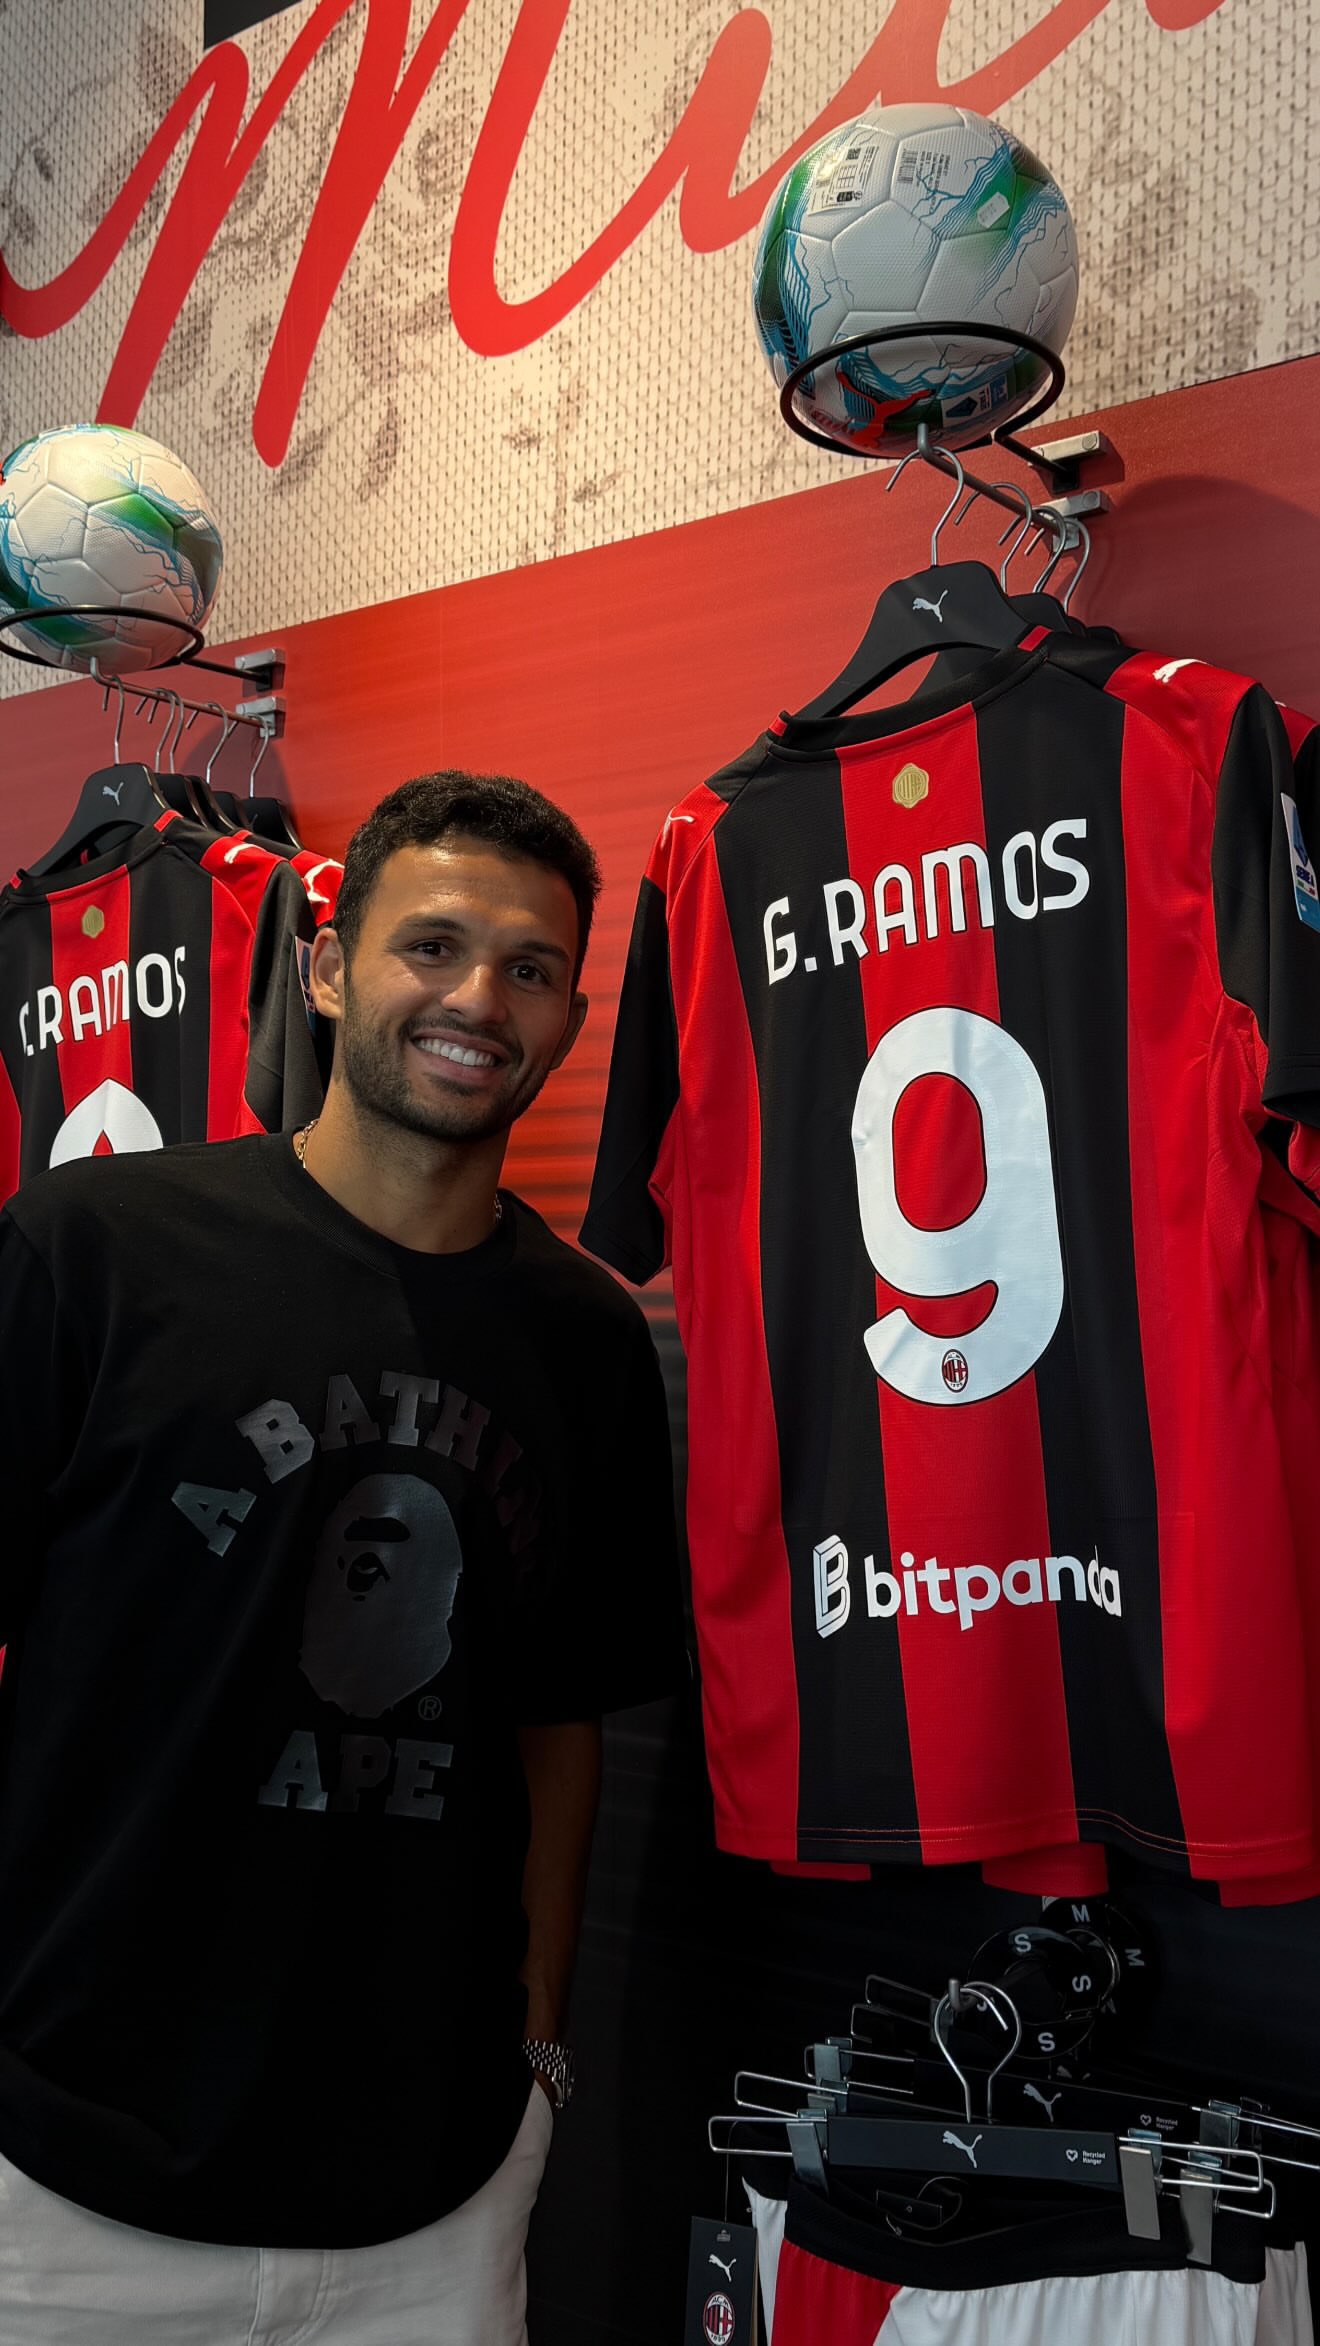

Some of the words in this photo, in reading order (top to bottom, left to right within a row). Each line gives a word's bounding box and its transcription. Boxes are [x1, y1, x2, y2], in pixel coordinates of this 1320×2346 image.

[851, 1008, 1064, 1404] 9
[171, 1481, 258, 1558] A
[864, 1544, 1122, 1631] bitpanda
[257, 1728, 456, 1822] APE
[1071, 1904, 1091, 1923] M
[1014, 1933, 1032, 1953] S
[1072, 1974, 1092, 1993] S
[1037, 2032, 1056, 2052] S
[1082, 2150, 1106, 2159] Recycled
[1082, 2157, 1102, 2166] Hanger
